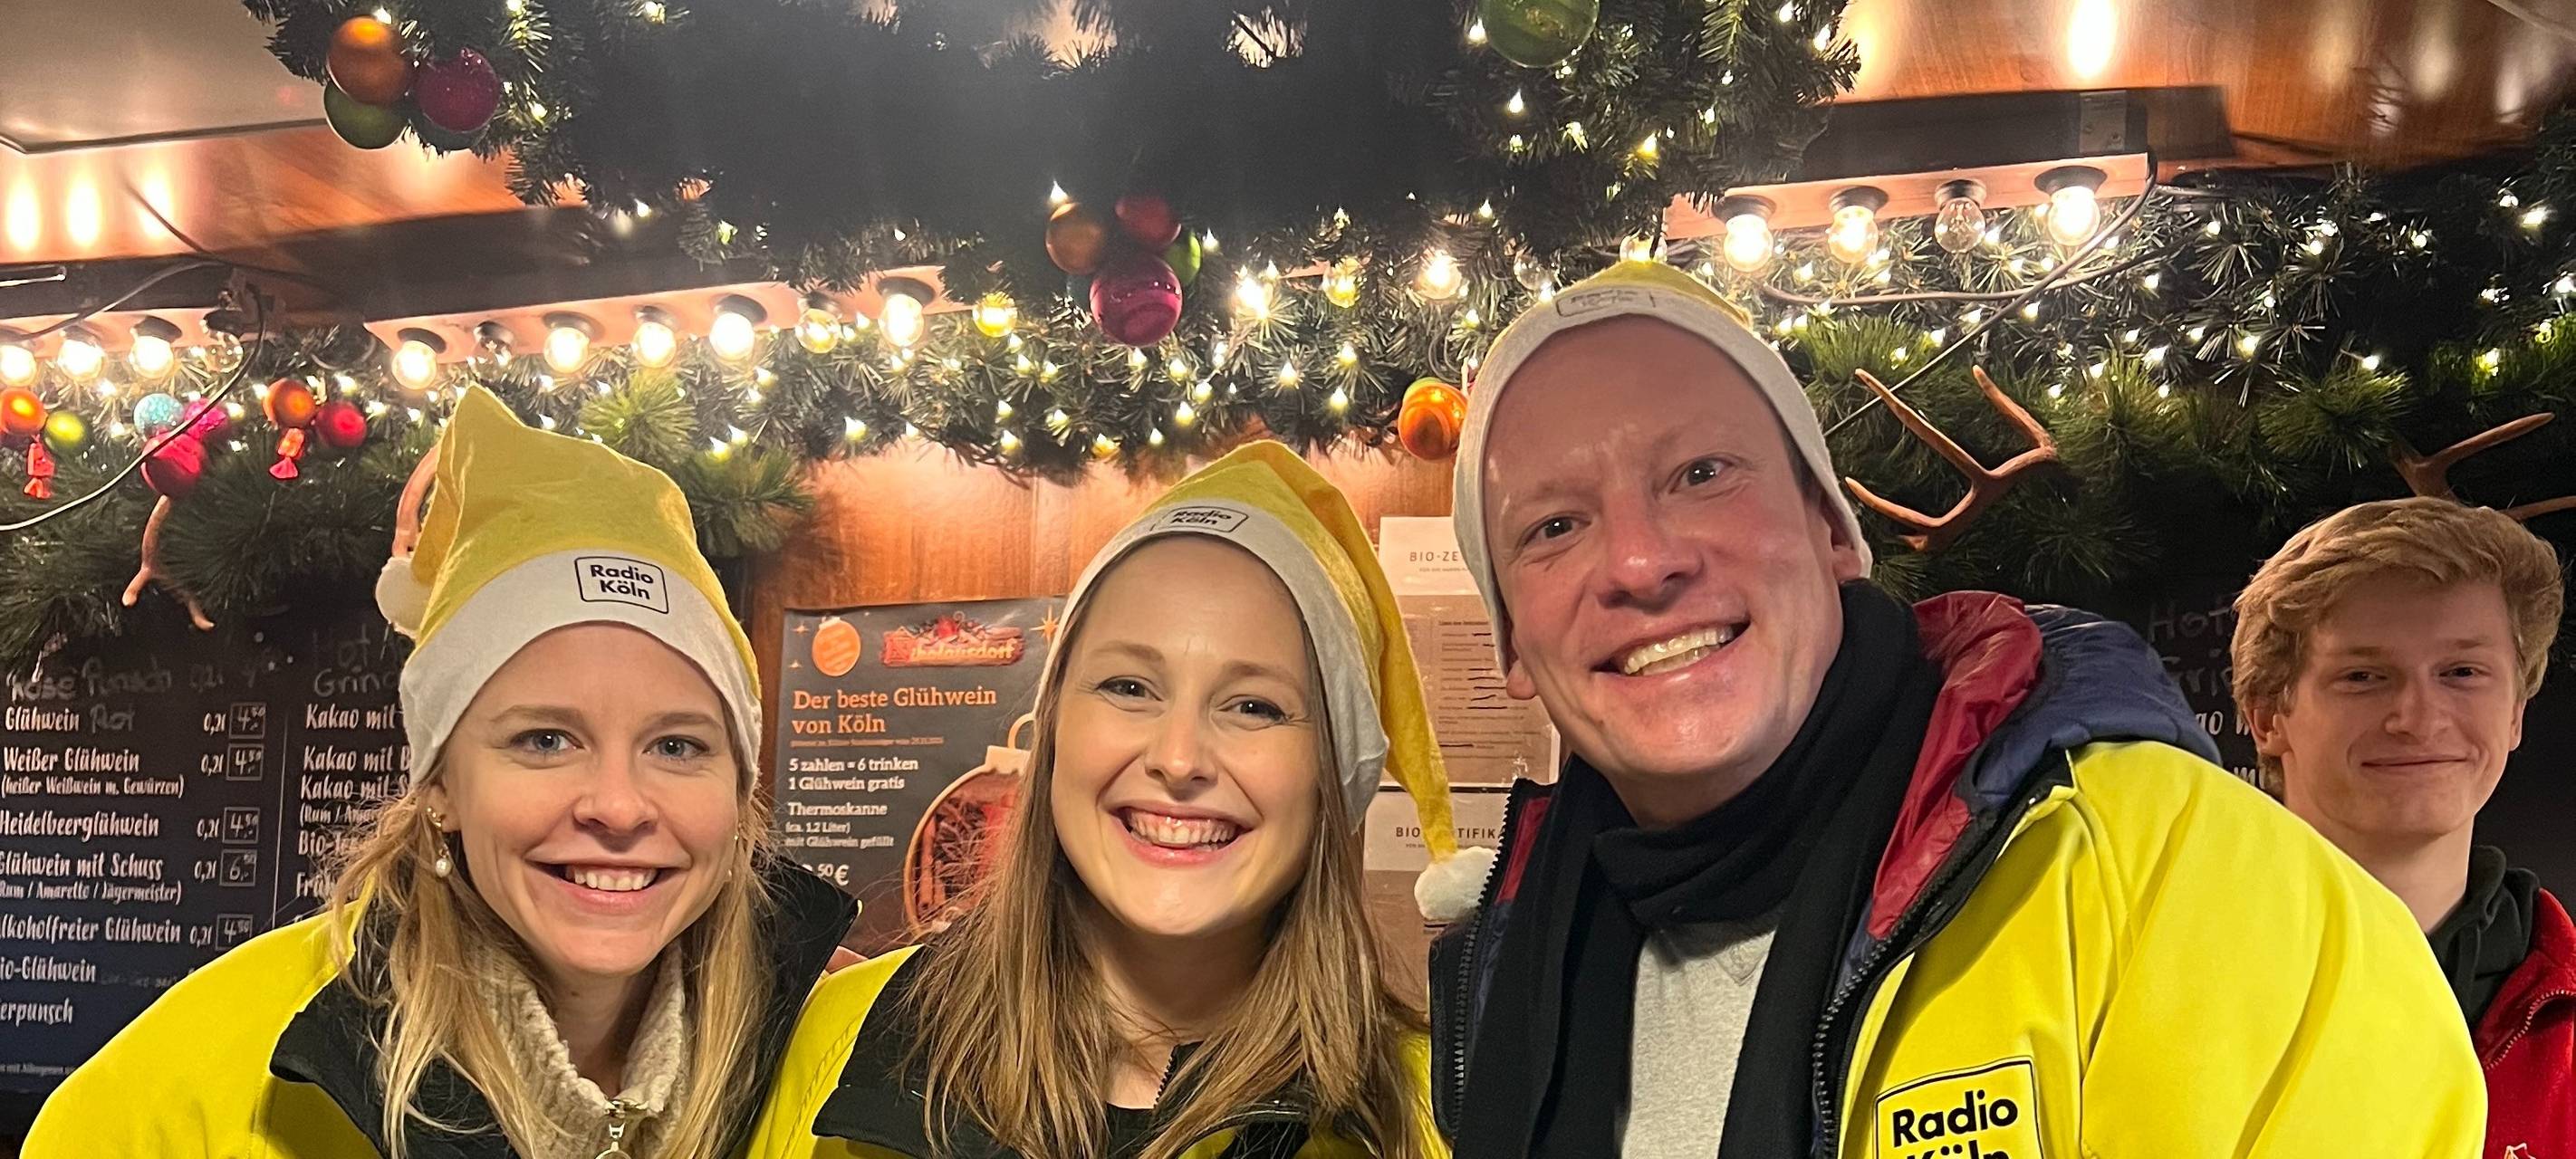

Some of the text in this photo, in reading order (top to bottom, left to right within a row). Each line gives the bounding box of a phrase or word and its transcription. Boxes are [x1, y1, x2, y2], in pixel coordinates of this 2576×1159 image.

[1409, 551, 1460, 562] BIO-ZE
[590, 564, 654, 584] Radio
[600, 580, 650, 599] Köln
[793, 685, 996, 710] Der beste Glühwein
[5, 705, 80, 732] Glühwein
[305, 703, 396, 730] Kakao mit
[792, 714, 886, 734] von Köln
[3, 746, 59, 772] Weißer
[64, 746, 139, 772] Glühwein
[303, 745, 357, 771] Kakao
[364, 745, 393, 771] mit
[789, 758, 799, 771] 5
[801, 758, 845, 771] zahlen
[857, 758, 867, 771] 6
[869, 757, 918, 771] trinken
[46, 776, 101, 795] Weißwein
[123, 776, 185, 799] Gewürzen)
[301, 774, 353, 800] Kakao
[361, 776, 389, 800] mit
[789, 775, 905, 792] 1 Glühwein gratis
[788, 801, 888, 815] Thermoskanne
[0, 809, 159, 842] Heidelbeerglühwein
[76, 853, 104, 878] mit
[110, 852, 163, 879] Schuss
[36, 881, 89, 899] Amaretto
[0, 914, 99, 944] lkoholfreier
[105, 915, 181, 944] Glühwein
[0, 955, 97, 983] io-Glühwein
[0, 998, 73, 1028] erpunsch
[1892, 1089, 2018, 1148] Radio
